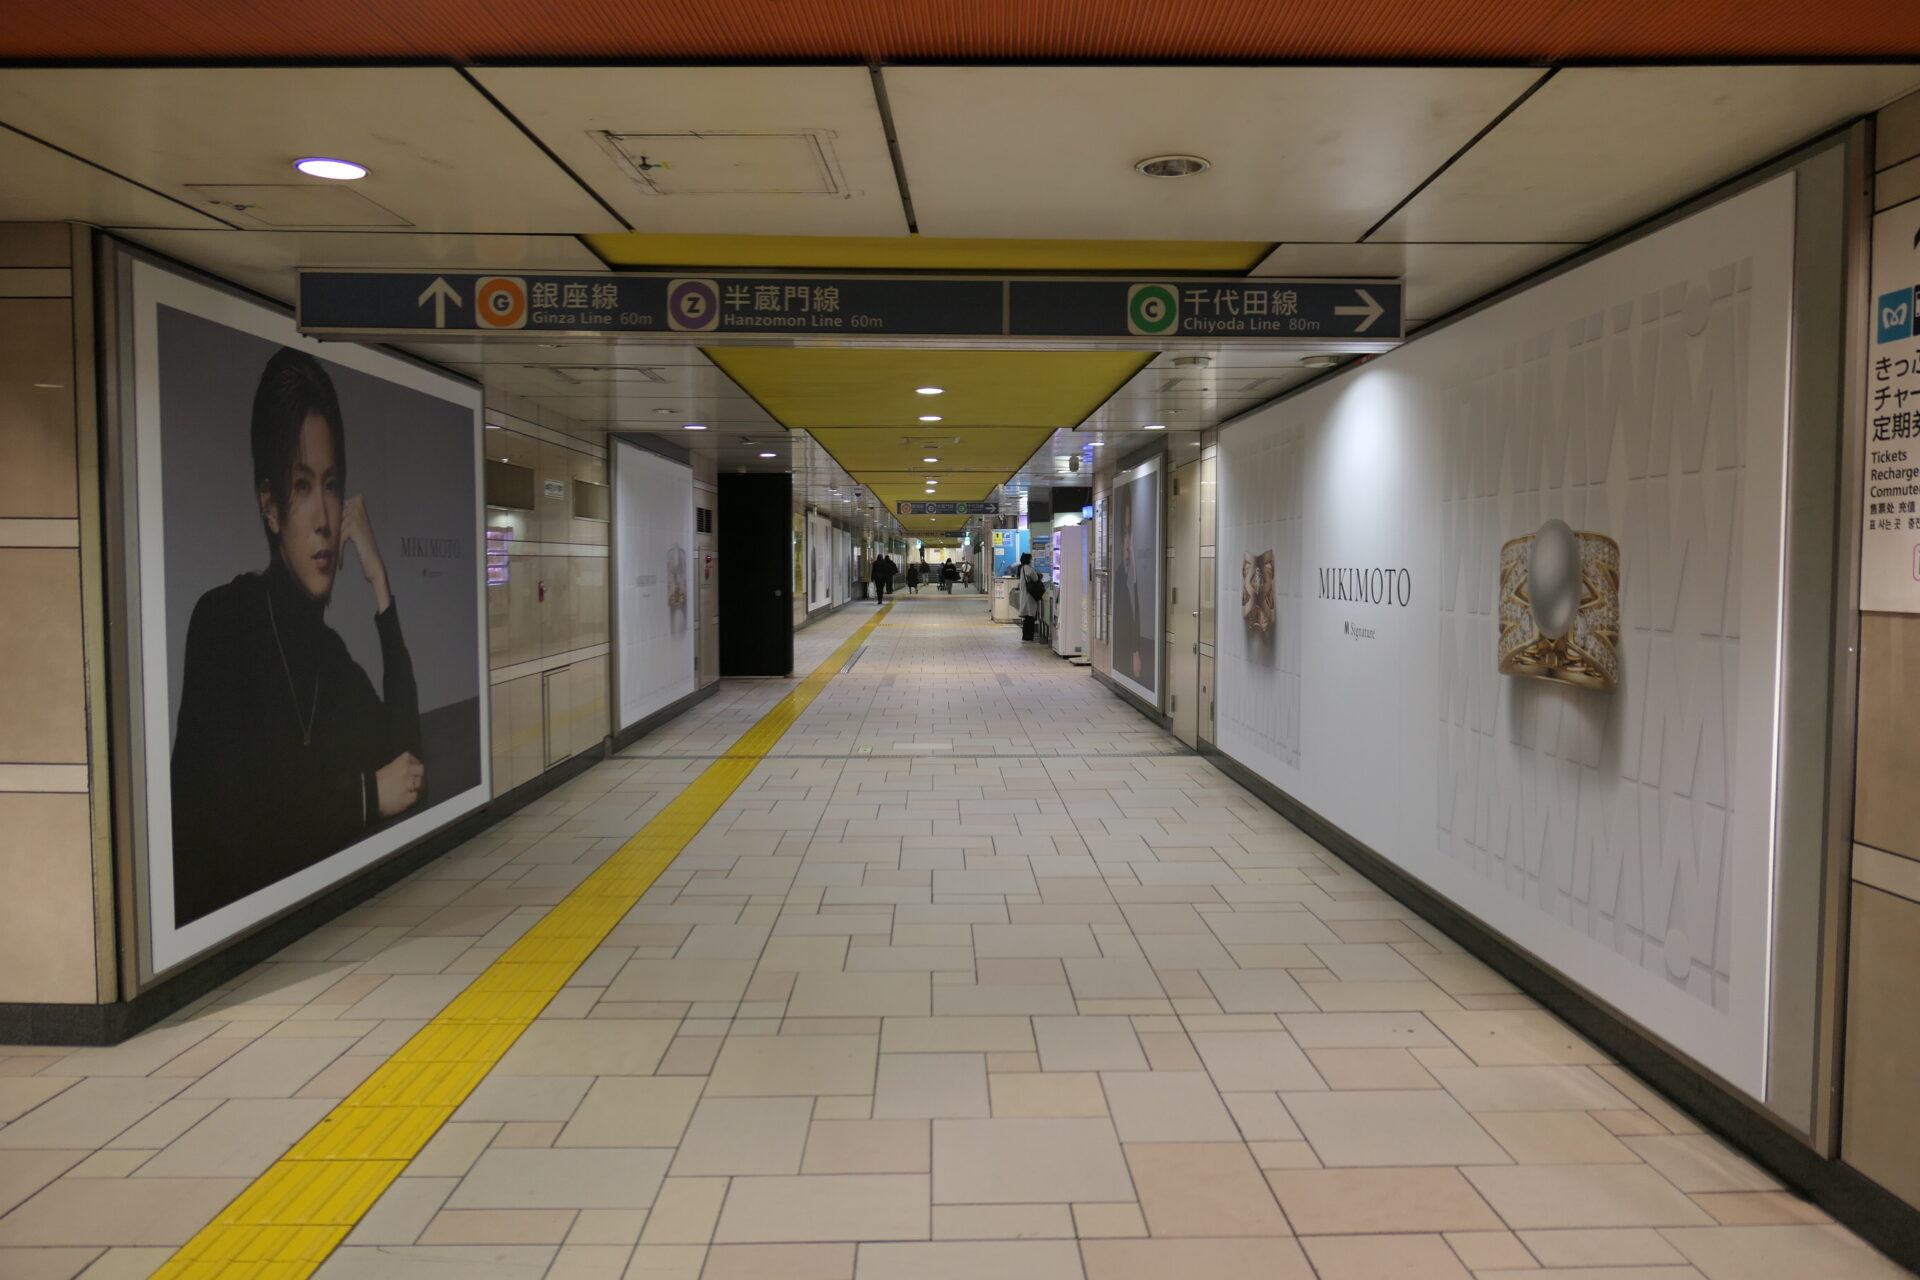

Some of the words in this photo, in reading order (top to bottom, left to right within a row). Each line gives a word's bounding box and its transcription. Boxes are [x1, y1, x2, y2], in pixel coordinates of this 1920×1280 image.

[493, 294, 511, 312] G
[532, 282, 619, 310] 銀座線
[724, 285, 840, 312] 半蔵門線
[1184, 289, 1298, 316] 千代田線
[687, 297, 700, 313] Z
[1145, 301, 1158, 317] C
[532, 311, 575, 324] Ginza
[581, 312, 612, 324] Line
[620, 312, 653, 325] 60m
[724, 314, 806, 327] Hanzomon
[811, 314, 843, 327] Line
[850, 314, 883, 328] 60m
[1184, 317, 1244, 332] Chiyoda
[1250, 318, 1281, 330] Line
[1288, 318, 1320, 331] 80m
[1871, 450, 1908, 464] Tickets
[1871, 466, 1919, 481] Recharge
[1870, 484, 1920, 498] Commute
[400, 536, 461, 559] MIKIMOTO
[1319, 567, 1411, 607] MIKIMOTO
